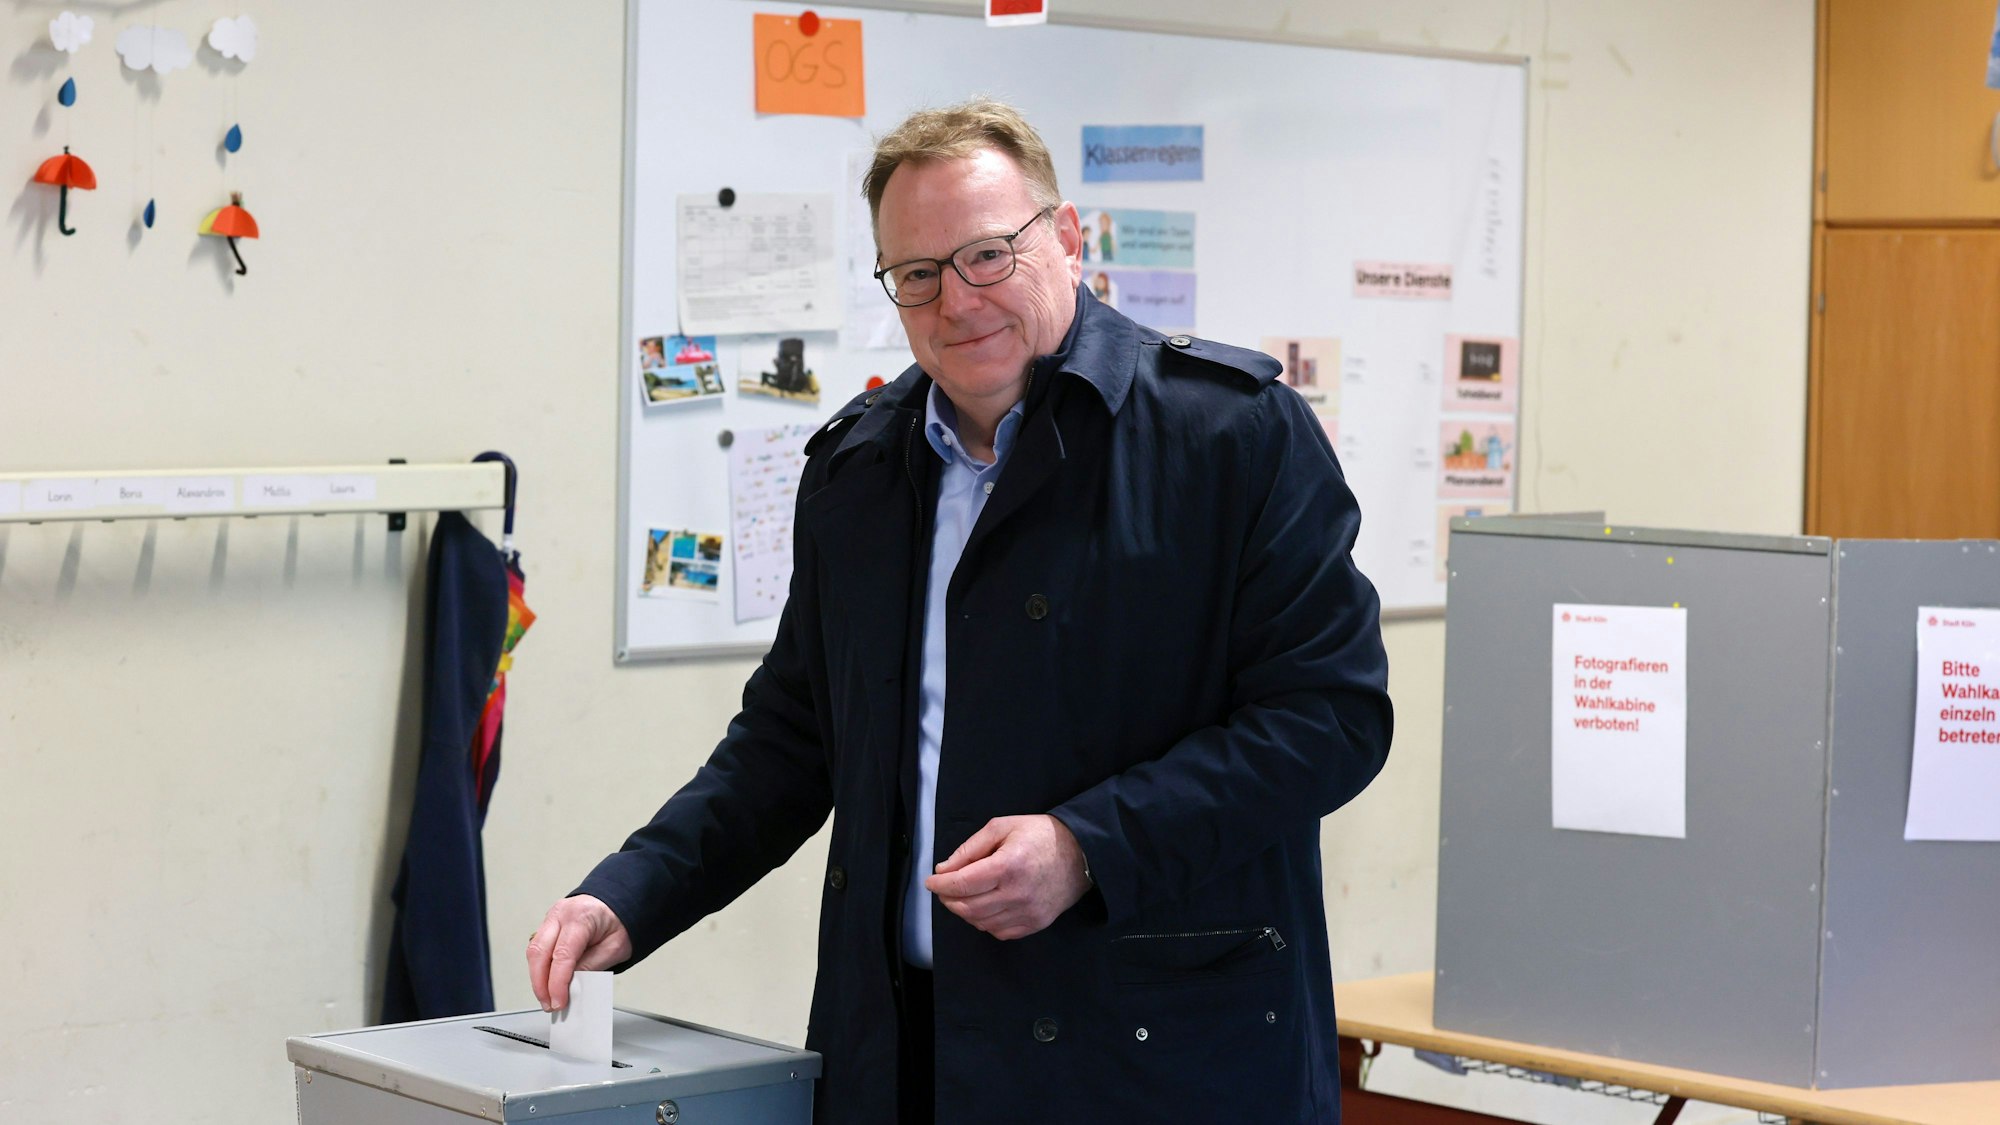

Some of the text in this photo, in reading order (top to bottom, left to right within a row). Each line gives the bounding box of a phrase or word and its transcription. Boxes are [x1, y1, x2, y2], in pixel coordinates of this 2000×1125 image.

[765, 38, 847, 89] OGS
[1084, 143, 1201, 166] Klassenregeln
[1356, 269, 1451, 289] Unsere Dienste
[330, 482, 356, 495] Laura
[1574, 655, 1669, 674] Fotografieren
[1942, 660, 1980, 677] Bitte
[1574, 674, 1612, 690] in der
[1941, 683, 2000, 700] Wahlka
[1574, 695, 1656, 713] Wahlkabine
[1940, 705, 1995, 722] einzeln
[1574, 716, 1640, 733] verboten!
